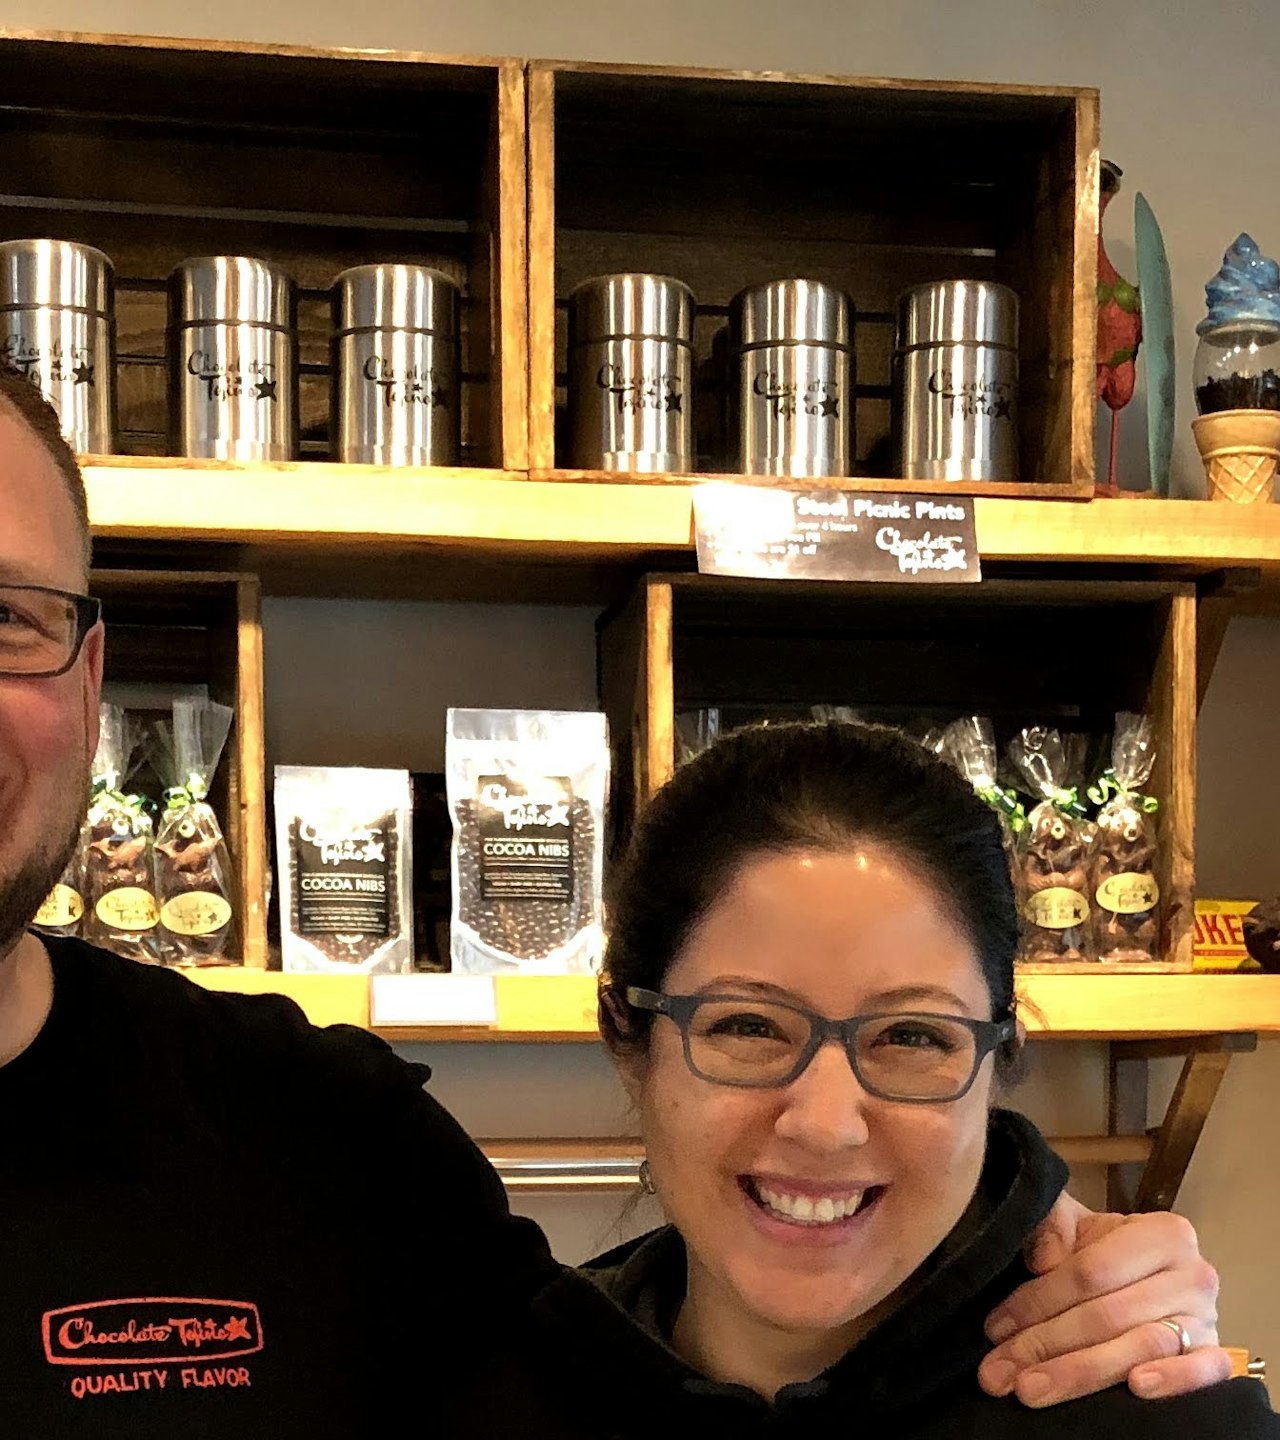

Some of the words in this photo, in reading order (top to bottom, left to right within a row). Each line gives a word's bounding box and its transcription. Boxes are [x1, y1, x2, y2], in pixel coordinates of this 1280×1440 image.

[854, 499, 911, 519] Picnic
[915, 501, 965, 520] Pints
[484, 843, 536, 856] COCOA
[538, 845, 570, 857] NIBS
[301, 878, 353, 891] COCOA
[355, 879, 386, 892] NIBS
[58, 1317, 171, 1350] Chocolate
[168, 1317, 229, 1347] Tofino
[71, 1369, 167, 1399] QUALITY
[180, 1367, 251, 1388] FLAVOR
